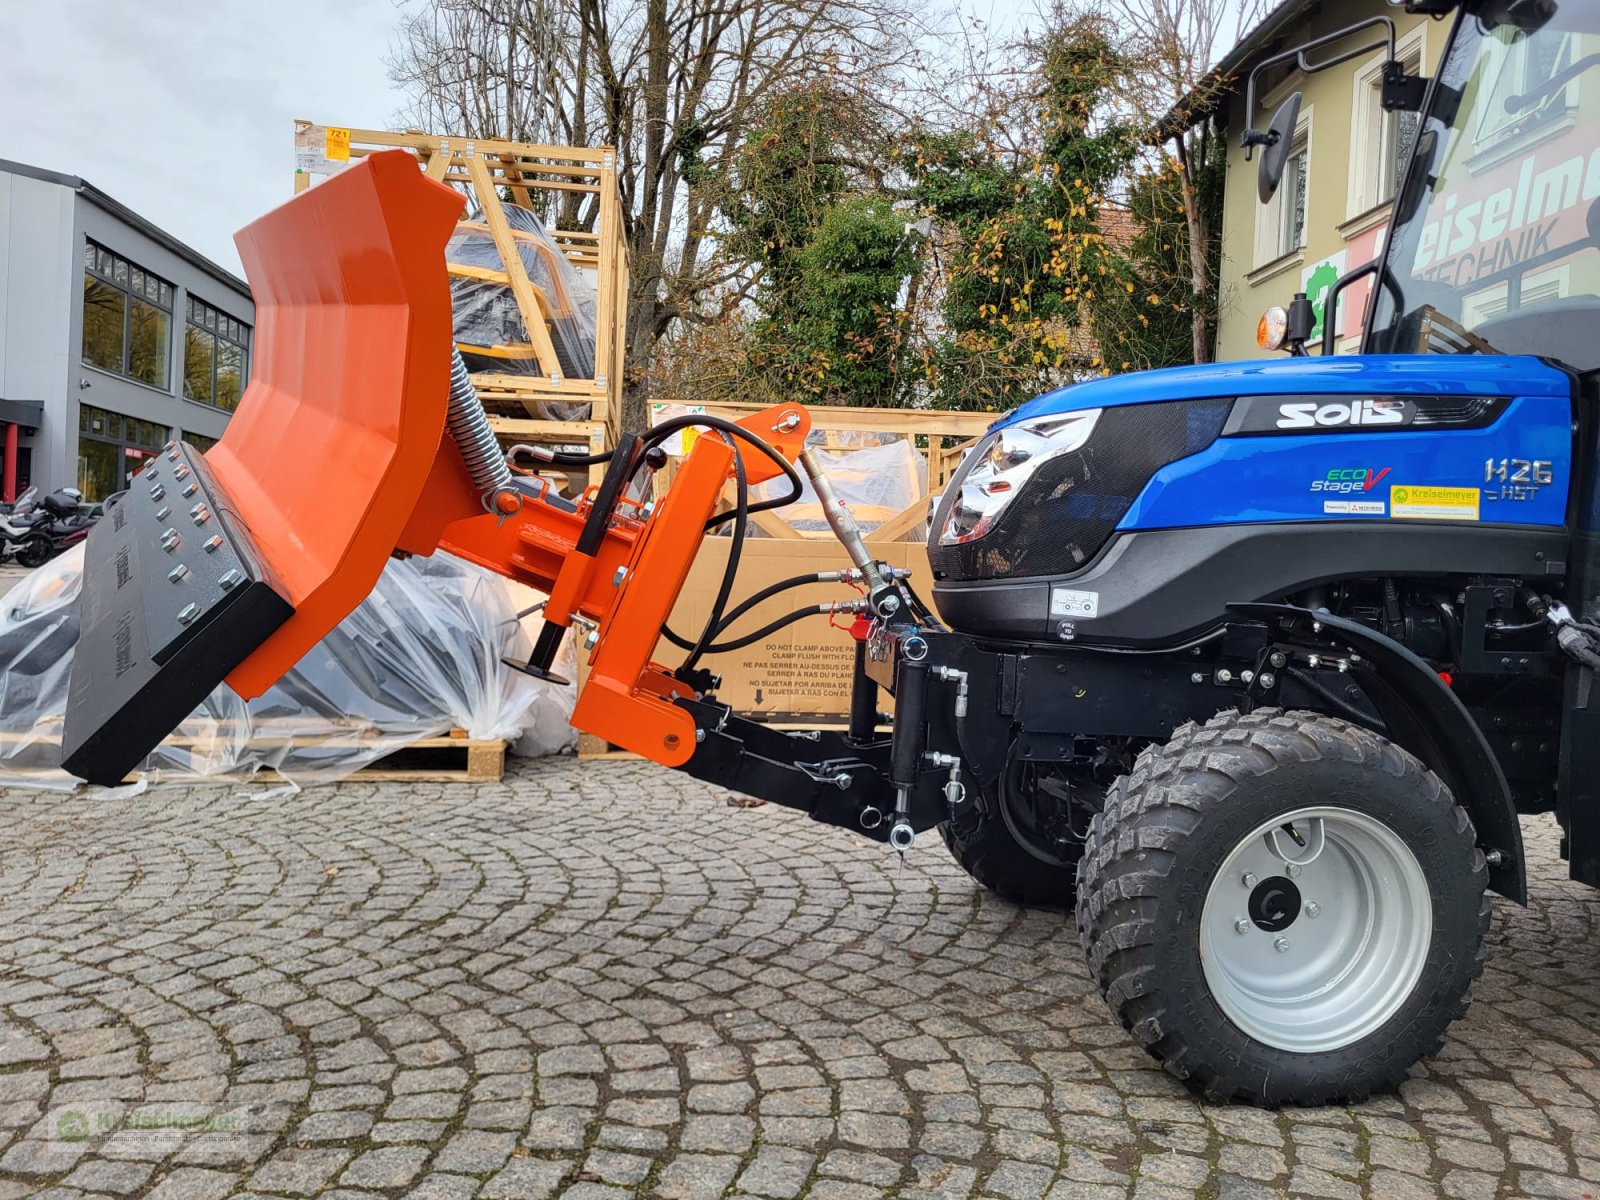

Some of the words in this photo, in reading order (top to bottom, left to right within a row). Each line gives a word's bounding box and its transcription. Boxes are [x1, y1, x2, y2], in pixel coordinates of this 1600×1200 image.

[1370, 147, 1600, 288] eiselm
[1327, 468, 1368, 481] ECO
[1484, 458, 1552, 484] H26
[1309, 480, 1365, 494] Stage
[1411, 487, 1477, 500] Kreiselmeyer
[768, 688, 799, 696] SUJETAR
[807, 689, 822, 697] RAS
